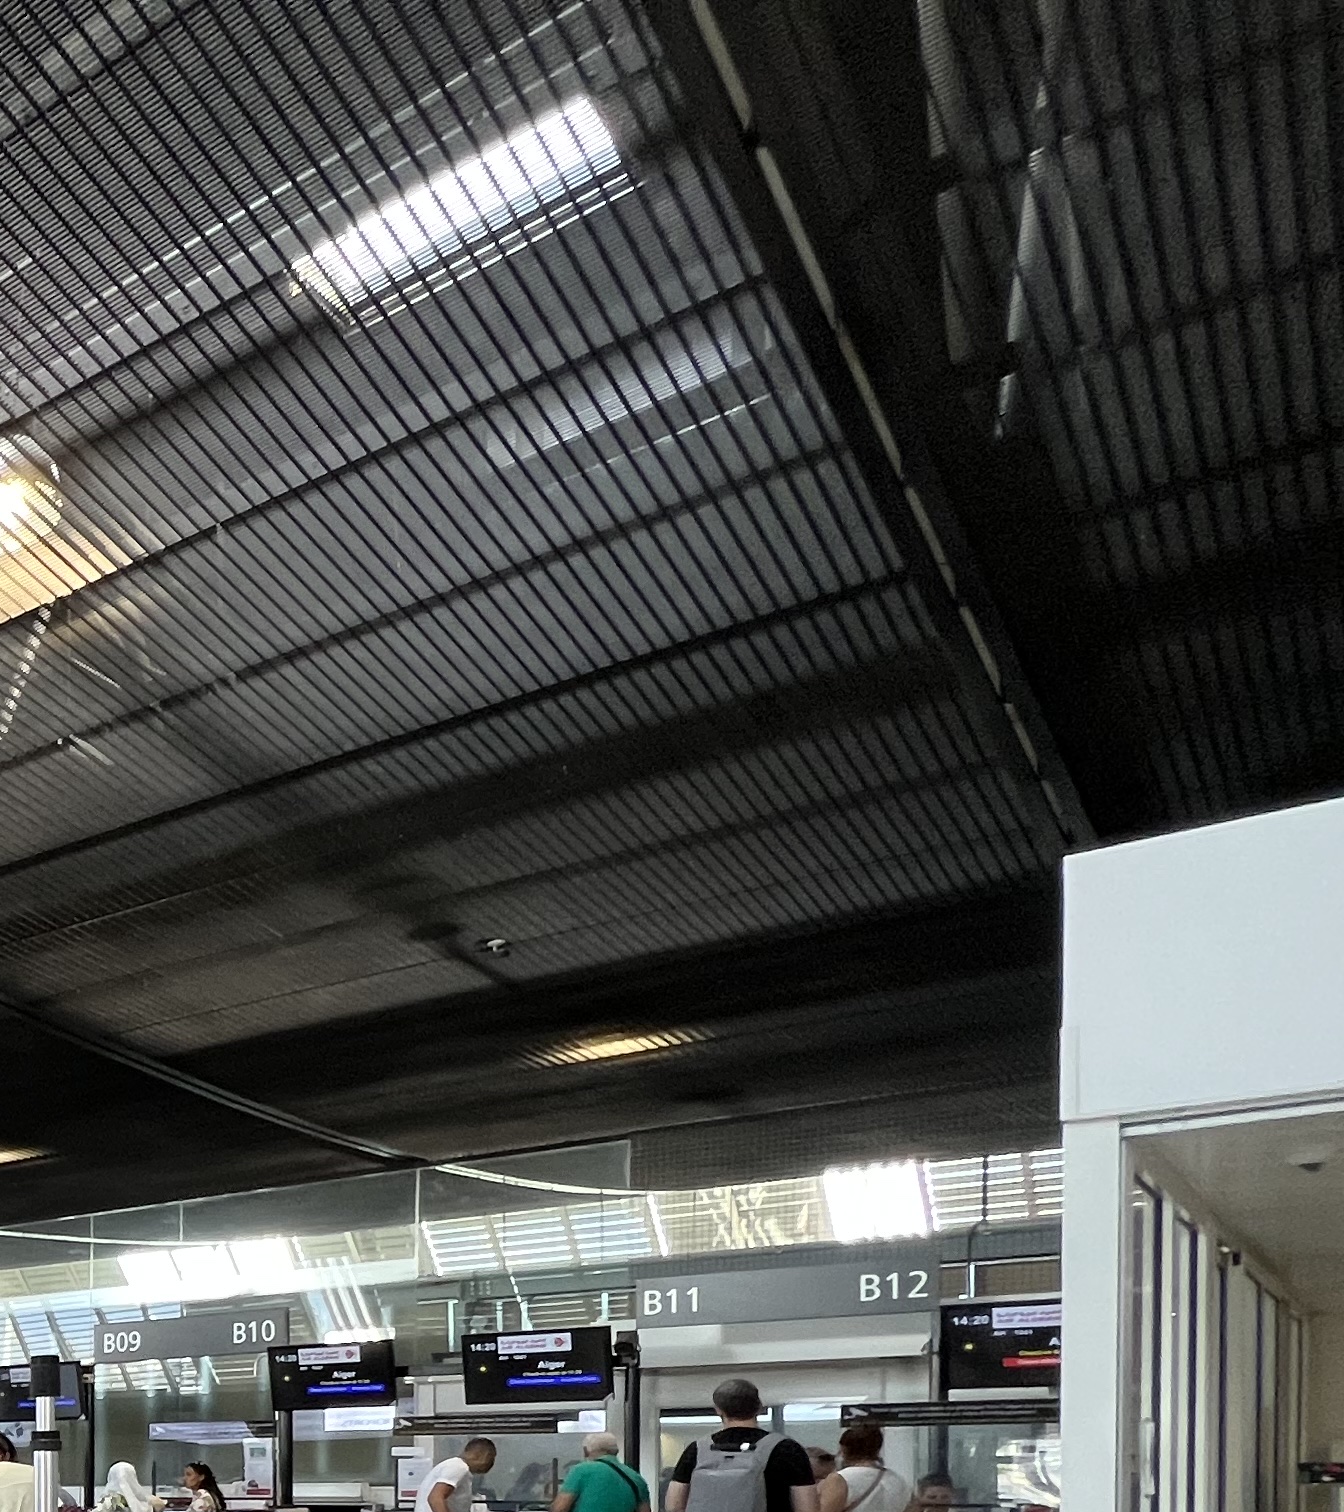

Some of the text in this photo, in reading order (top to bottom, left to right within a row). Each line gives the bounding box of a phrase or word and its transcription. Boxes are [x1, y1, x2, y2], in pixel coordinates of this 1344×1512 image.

[859, 1270, 929, 1302] B12
[643, 1286, 700, 1316] B11
[103, 1330, 142, 1354] B09
[232, 1319, 276, 1344] B10
